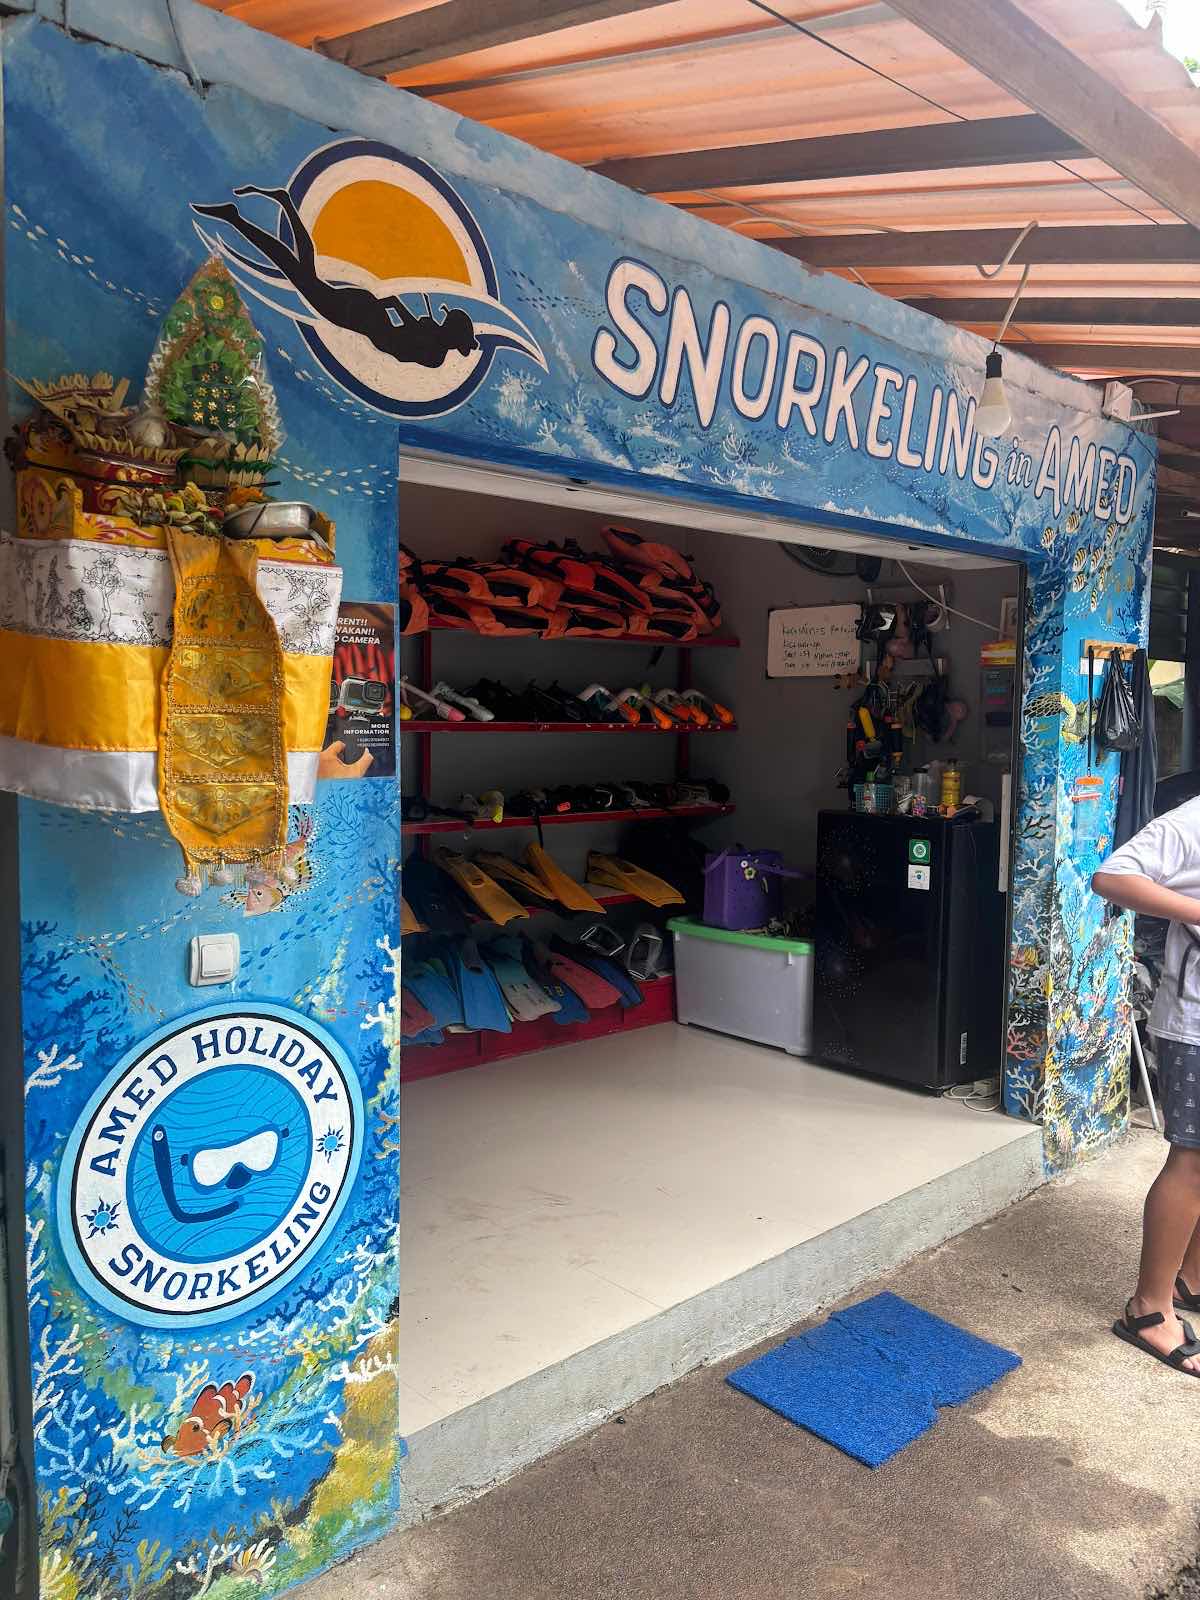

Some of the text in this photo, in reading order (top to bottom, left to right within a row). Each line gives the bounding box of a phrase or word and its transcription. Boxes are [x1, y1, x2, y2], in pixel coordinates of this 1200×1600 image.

[592, 256, 1137, 525] SNORKELING in AMED
[341, 635, 380, 644] CAMERA
[90, 1025, 338, 1177] AMED HOLIDAY
[108, 1181, 331, 1300] SNORKELING
